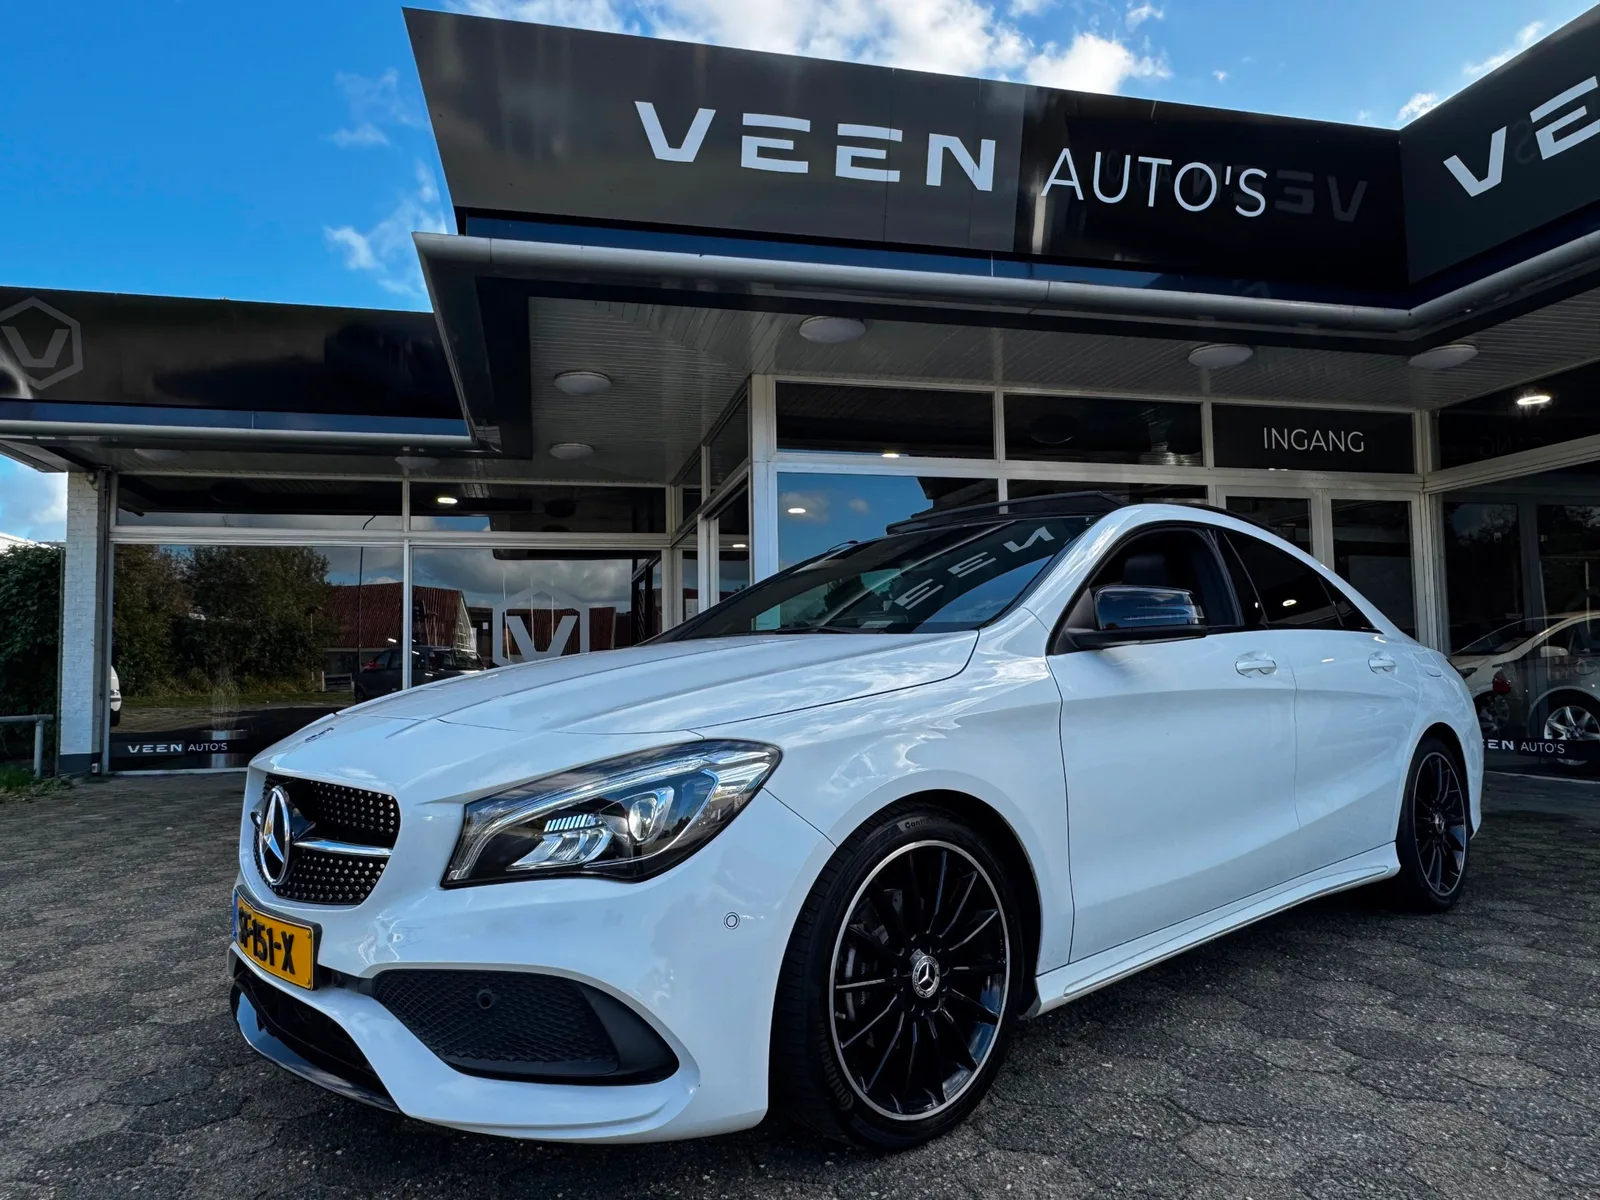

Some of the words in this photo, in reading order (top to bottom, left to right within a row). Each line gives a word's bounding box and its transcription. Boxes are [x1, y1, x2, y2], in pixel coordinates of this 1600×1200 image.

[1443, 75, 1600, 198] VE
[634, 101, 996, 192] VEEN
[1041, 147, 1268, 218] AUTO'S
[1, 326, 70, 368] V
[1263, 427, 1364, 453] INGANG
[506, 615, 578, 662] V
[127, 743, 182, 754] VEEN
[188, 742, 228, 752] AUTO'S
[1482, 739, 1515, 751] EN
[1520, 742, 1565, 754] AUTO'S
